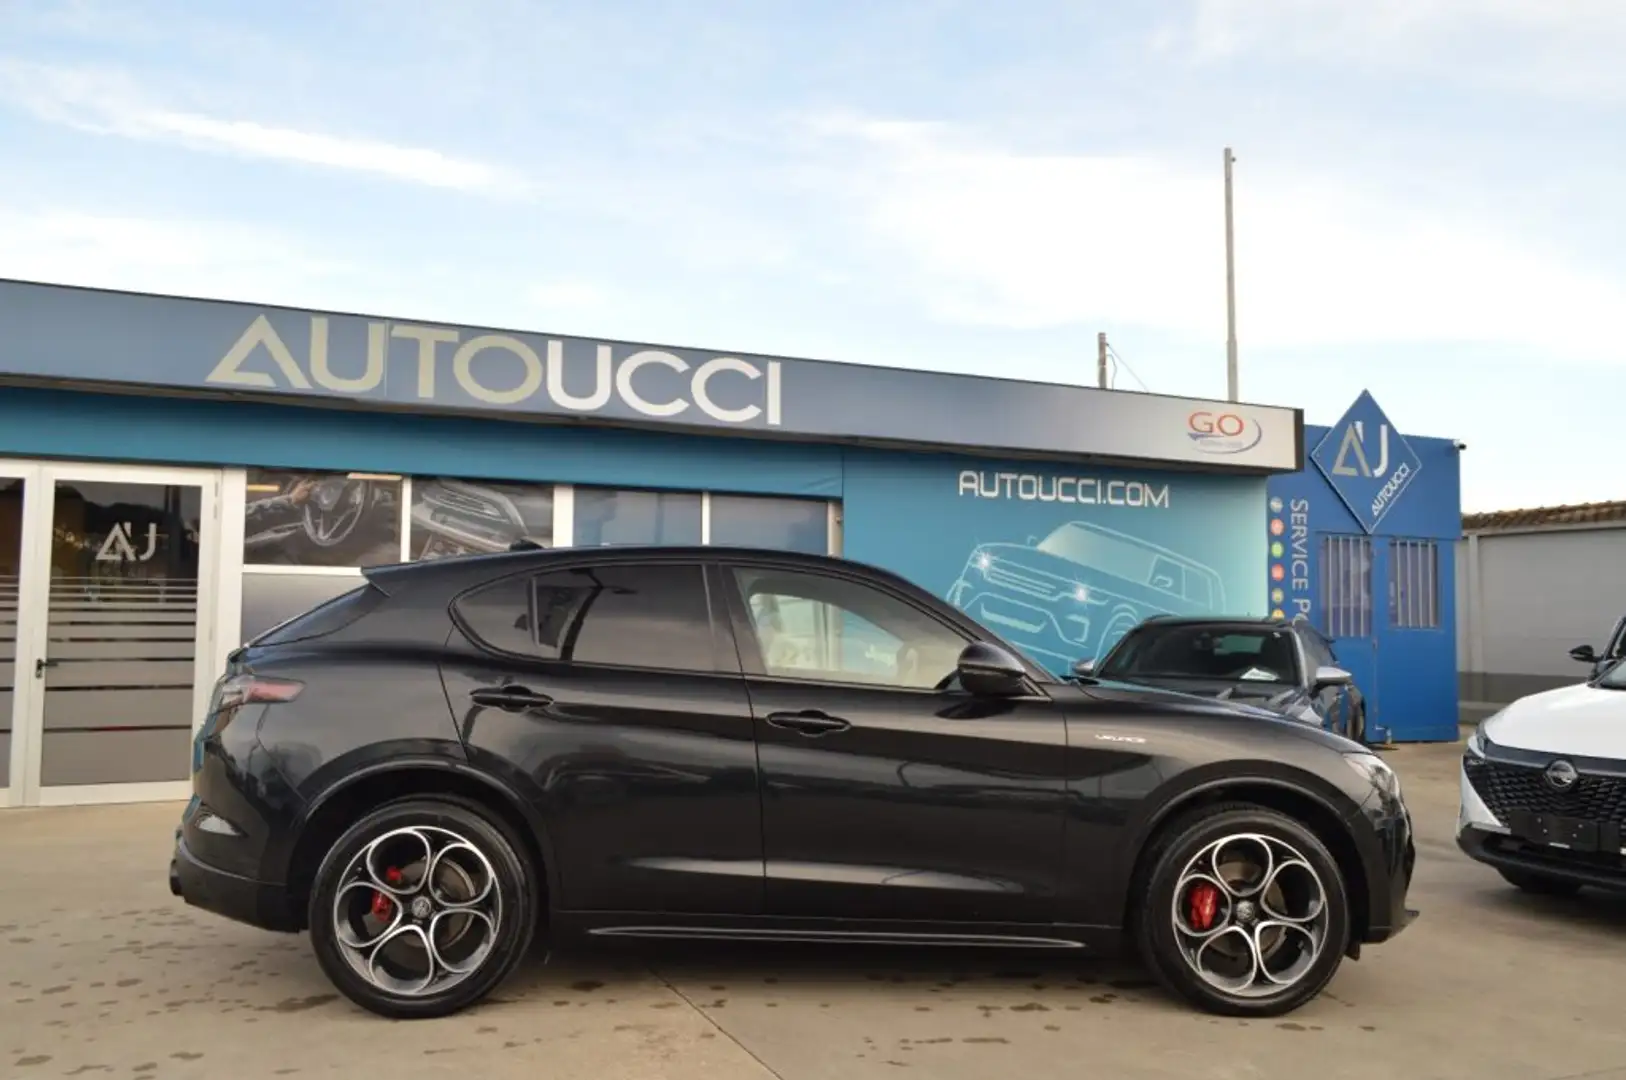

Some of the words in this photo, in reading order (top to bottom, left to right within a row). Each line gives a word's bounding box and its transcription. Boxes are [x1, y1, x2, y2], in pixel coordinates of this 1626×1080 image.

[204, 313, 782, 426] AUTOUCCI
[1188, 411, 1245, 437] GO
[958, 470, 1169, 509] AUTOUCCI.COM
[1371, 462, 1410, 517] AUTOUCCI
[1290, 498, 1309, 591] SERVICE
